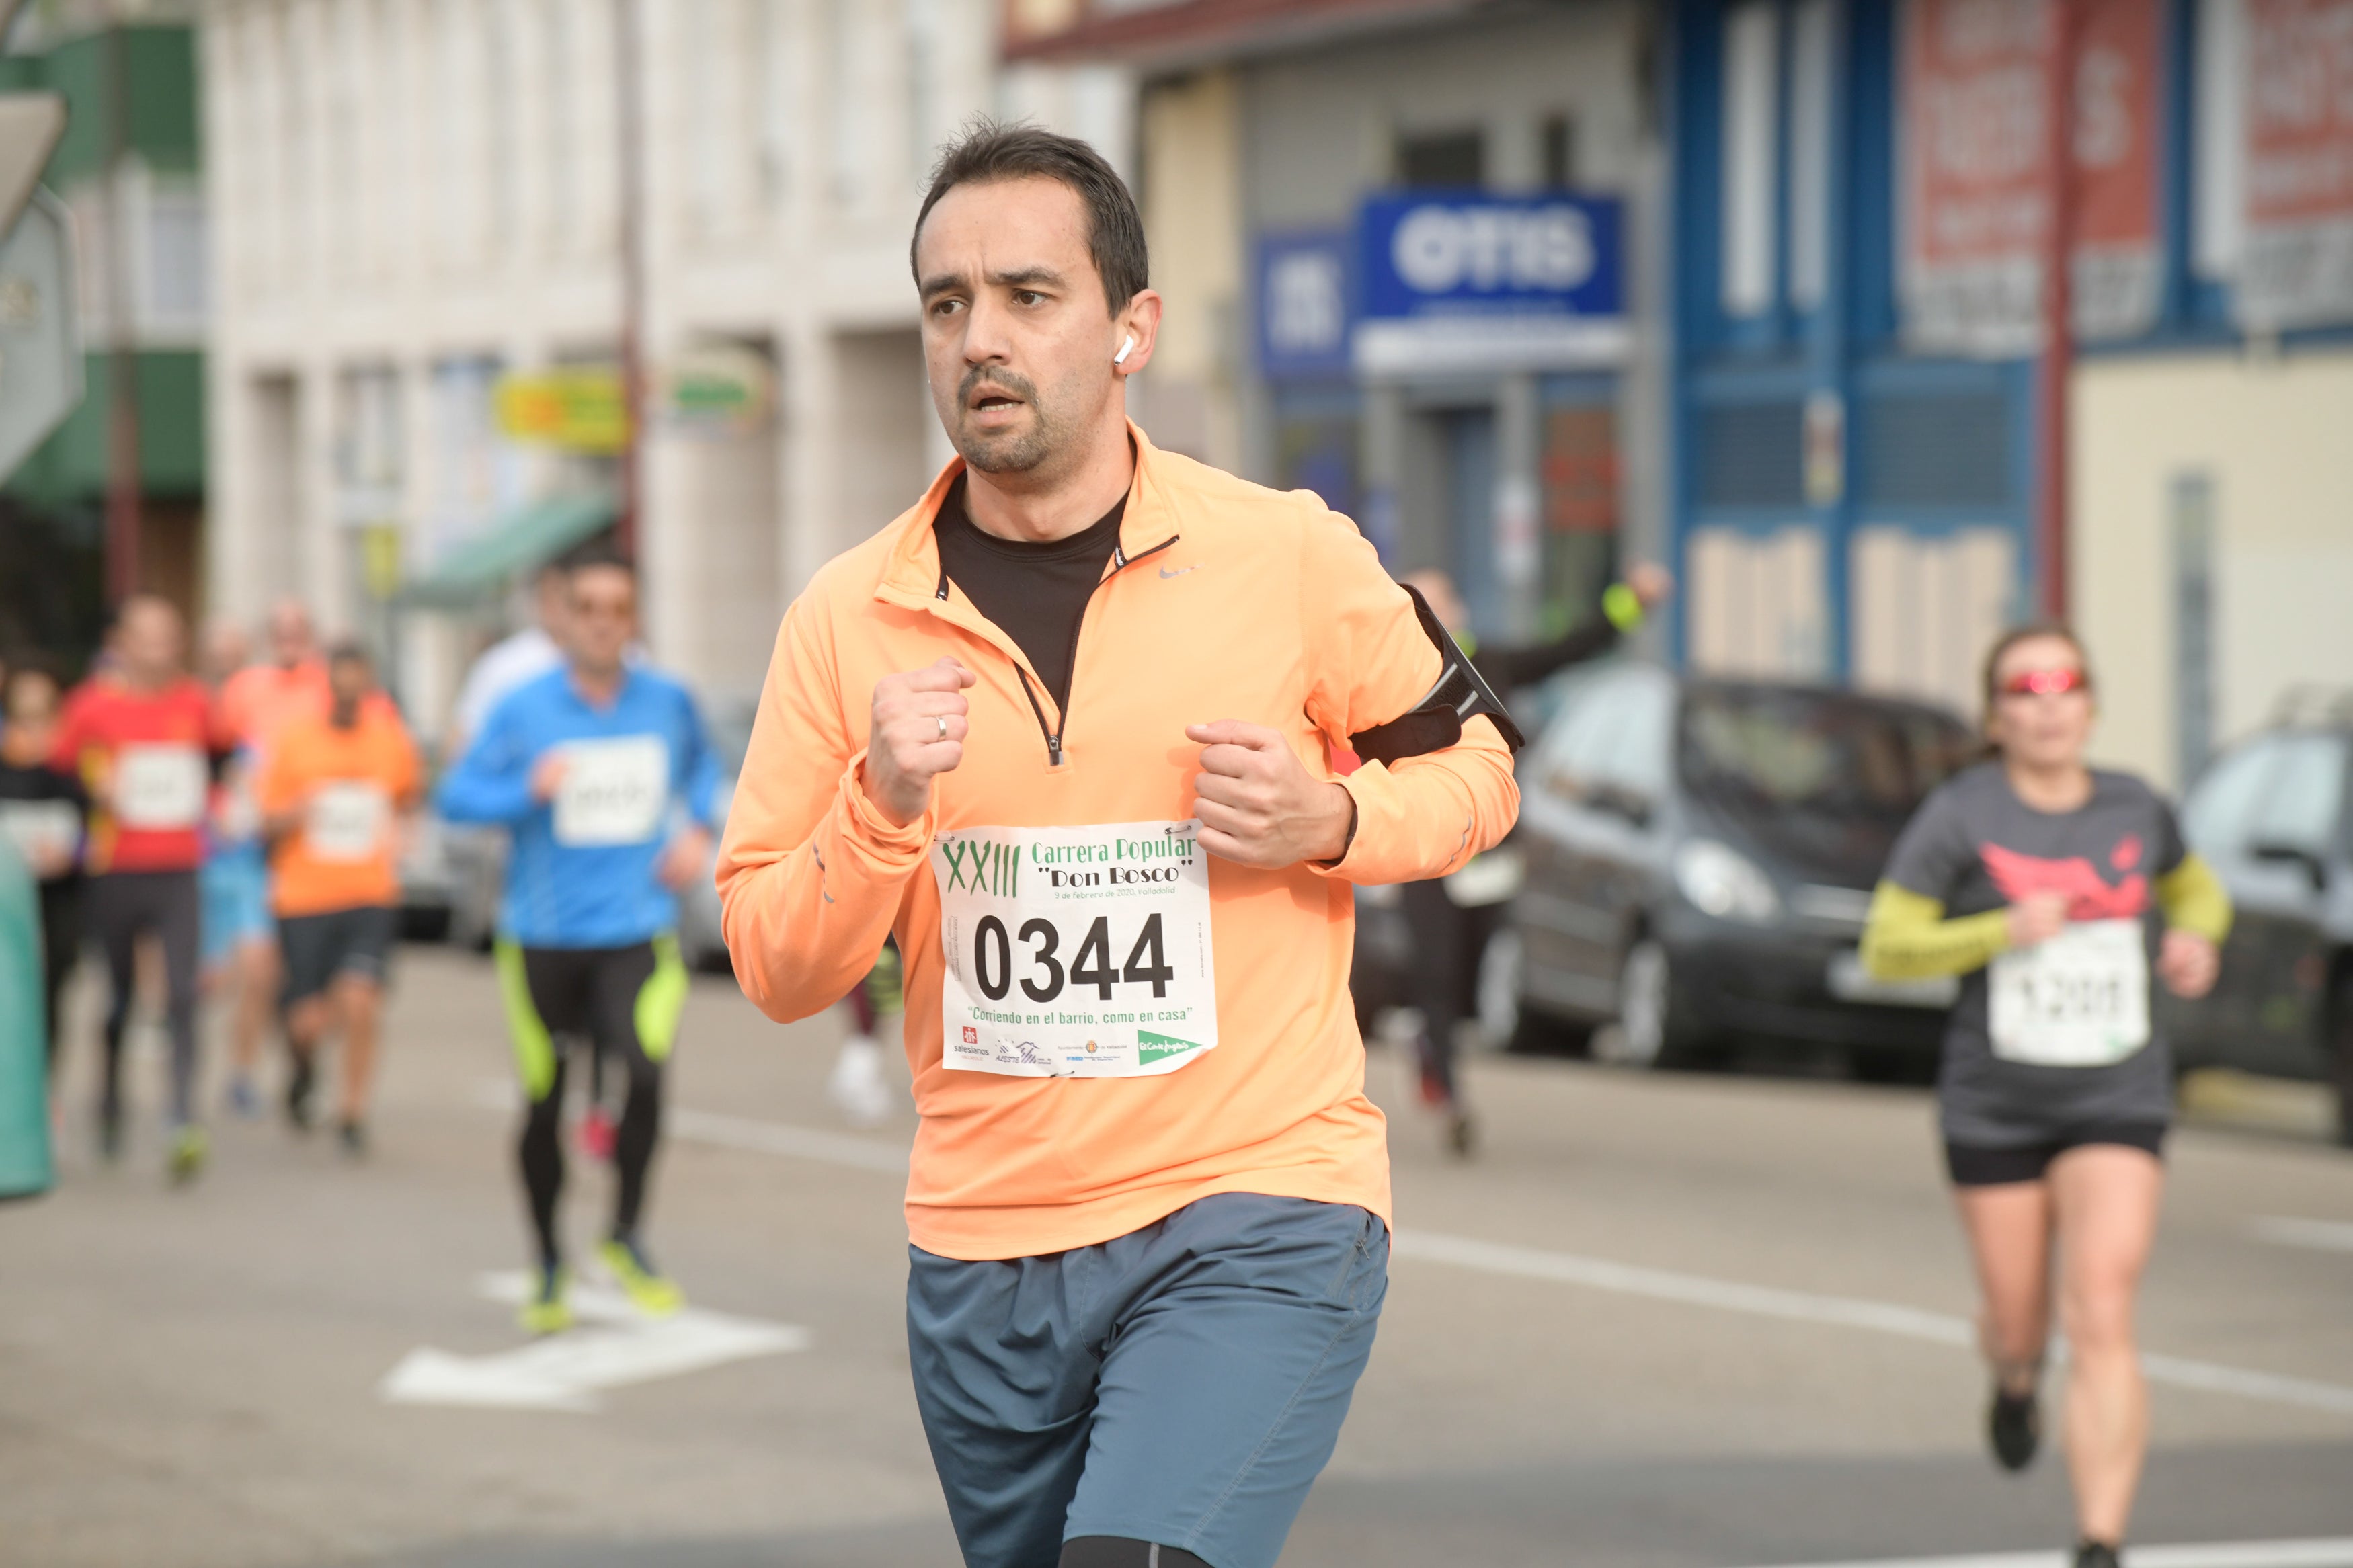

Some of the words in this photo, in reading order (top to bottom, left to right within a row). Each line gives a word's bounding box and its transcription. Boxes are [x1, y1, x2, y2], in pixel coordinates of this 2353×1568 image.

[1393, 205, 1594, 291] OTIS
[1032, 842, 1109, 864] Carrera
[1116, 835, 1196, 862] Popular
[943, 840, 1021, 898] XXIII
[1062, 891, 1071, 899] de
[1072, 891, 1104, 899] febrero
[1117, 888, 1137, 897] 2020,
[974, 913, 1174, 1003] 0344
[1027, 1014, 1039, 1024] en
[1044, 1012, 1054, 1024] el
[1059, 1012, 1098, 1025] barrio,
[1103, 1013, 1135, 1023] como
[1140, 1012, 1154, 1022] en
[954, 1045, 990, 1056] salesianos
